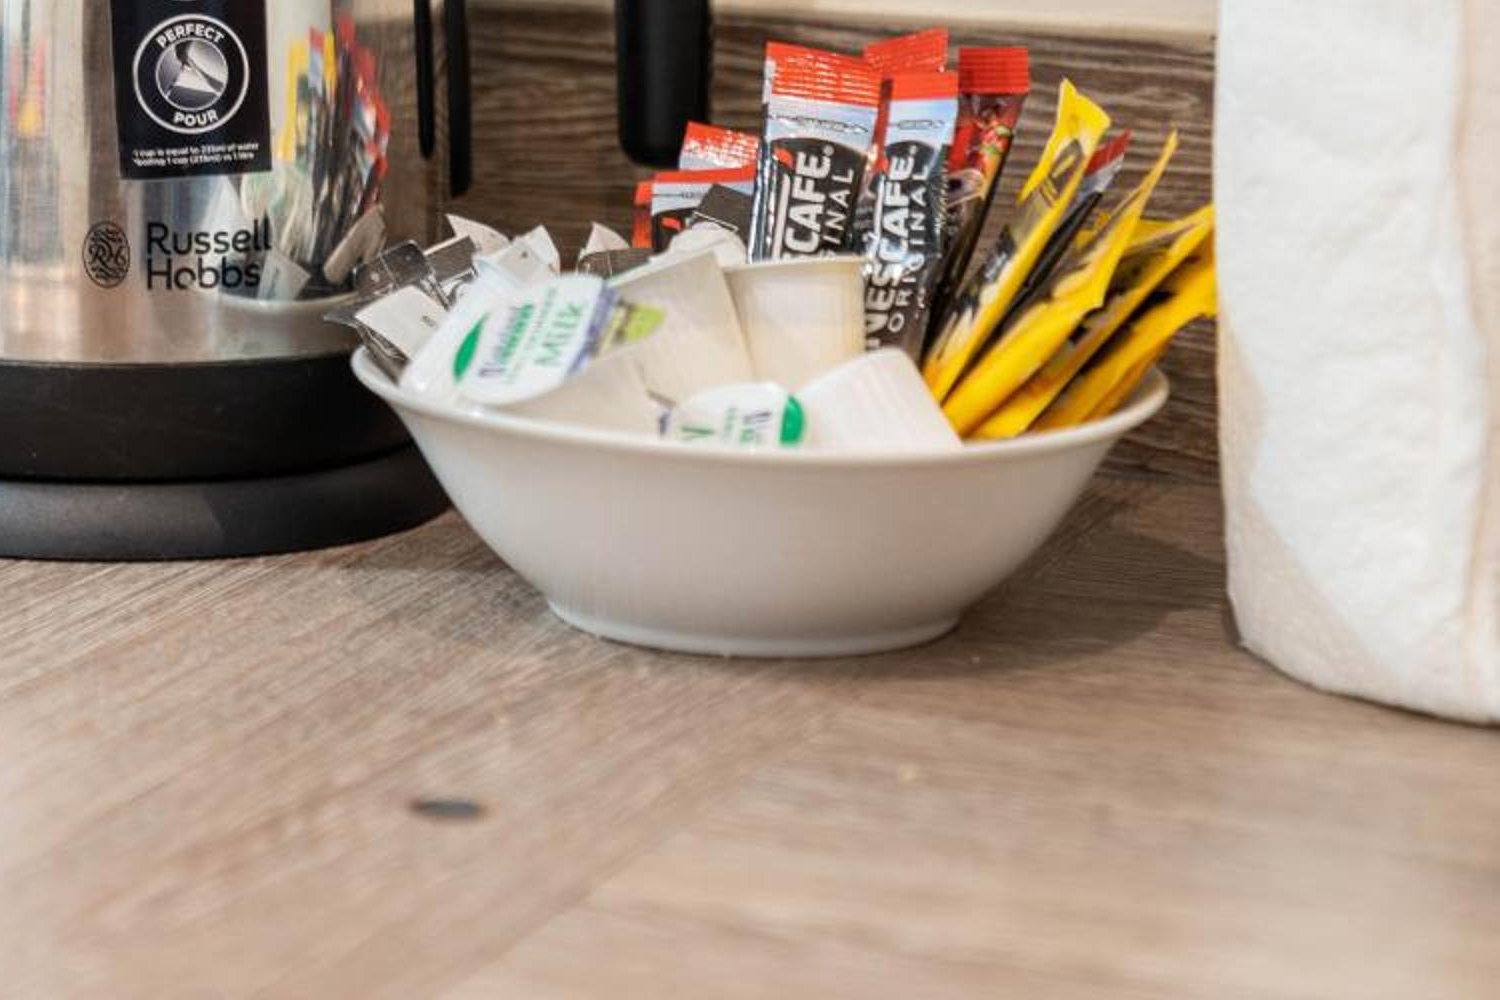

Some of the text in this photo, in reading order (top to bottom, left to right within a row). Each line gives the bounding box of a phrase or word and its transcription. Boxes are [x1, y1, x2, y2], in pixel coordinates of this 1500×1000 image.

[156, 23, 225, 127] PERFECT POUR
[146, 217, 272, 256] Russell
[887, 164, 929, 333] ORIGINAL
[146, 255, 262, 290] Hobbs
